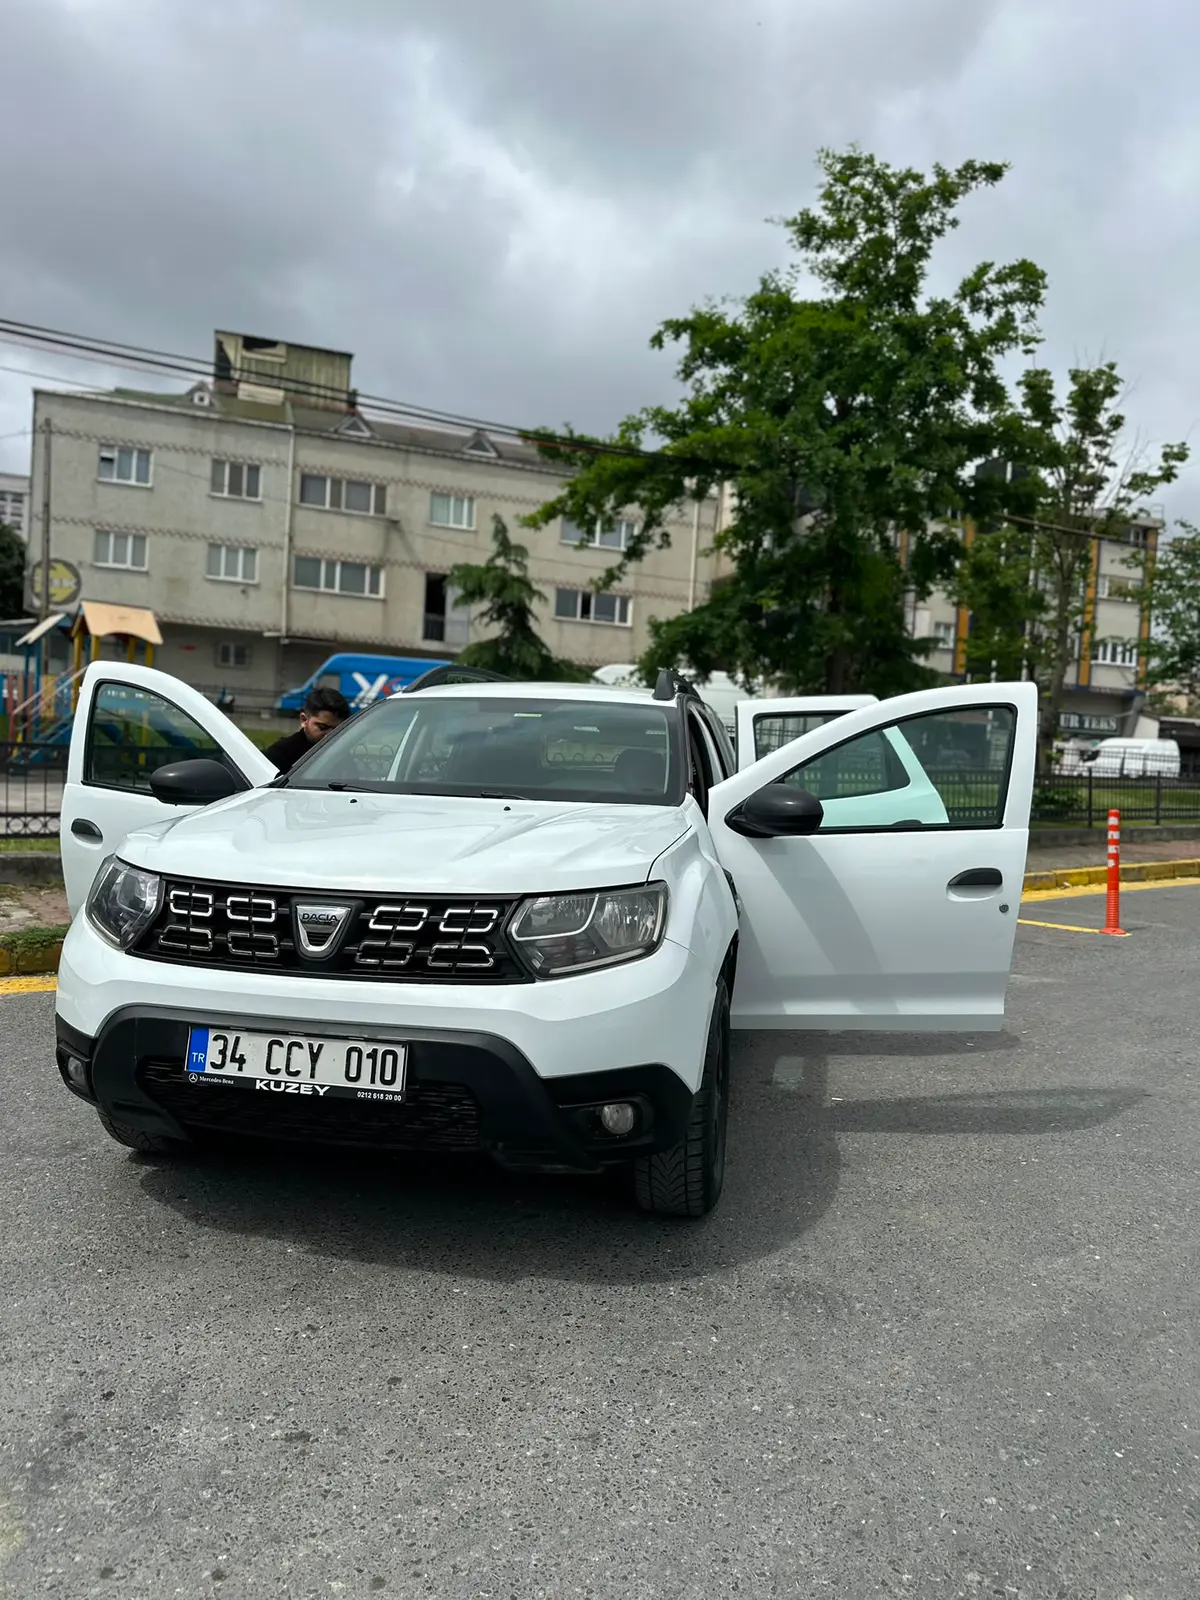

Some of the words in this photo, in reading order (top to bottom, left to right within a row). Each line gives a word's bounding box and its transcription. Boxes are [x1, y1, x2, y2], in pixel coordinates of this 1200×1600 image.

[302, 913, 338, 921] DACIA
[191, 1052, 205, 1064] TR
[209, 1034, 246, 1071] 34
[265, 1039, 324, 1079] CCY
[345, 1046, 398, 1085] 010
[255, 1080, 330, 1096] KUZEY
[356, 1091, 372, 1099] 0212
[393, 1094, 402, 1102] 00
